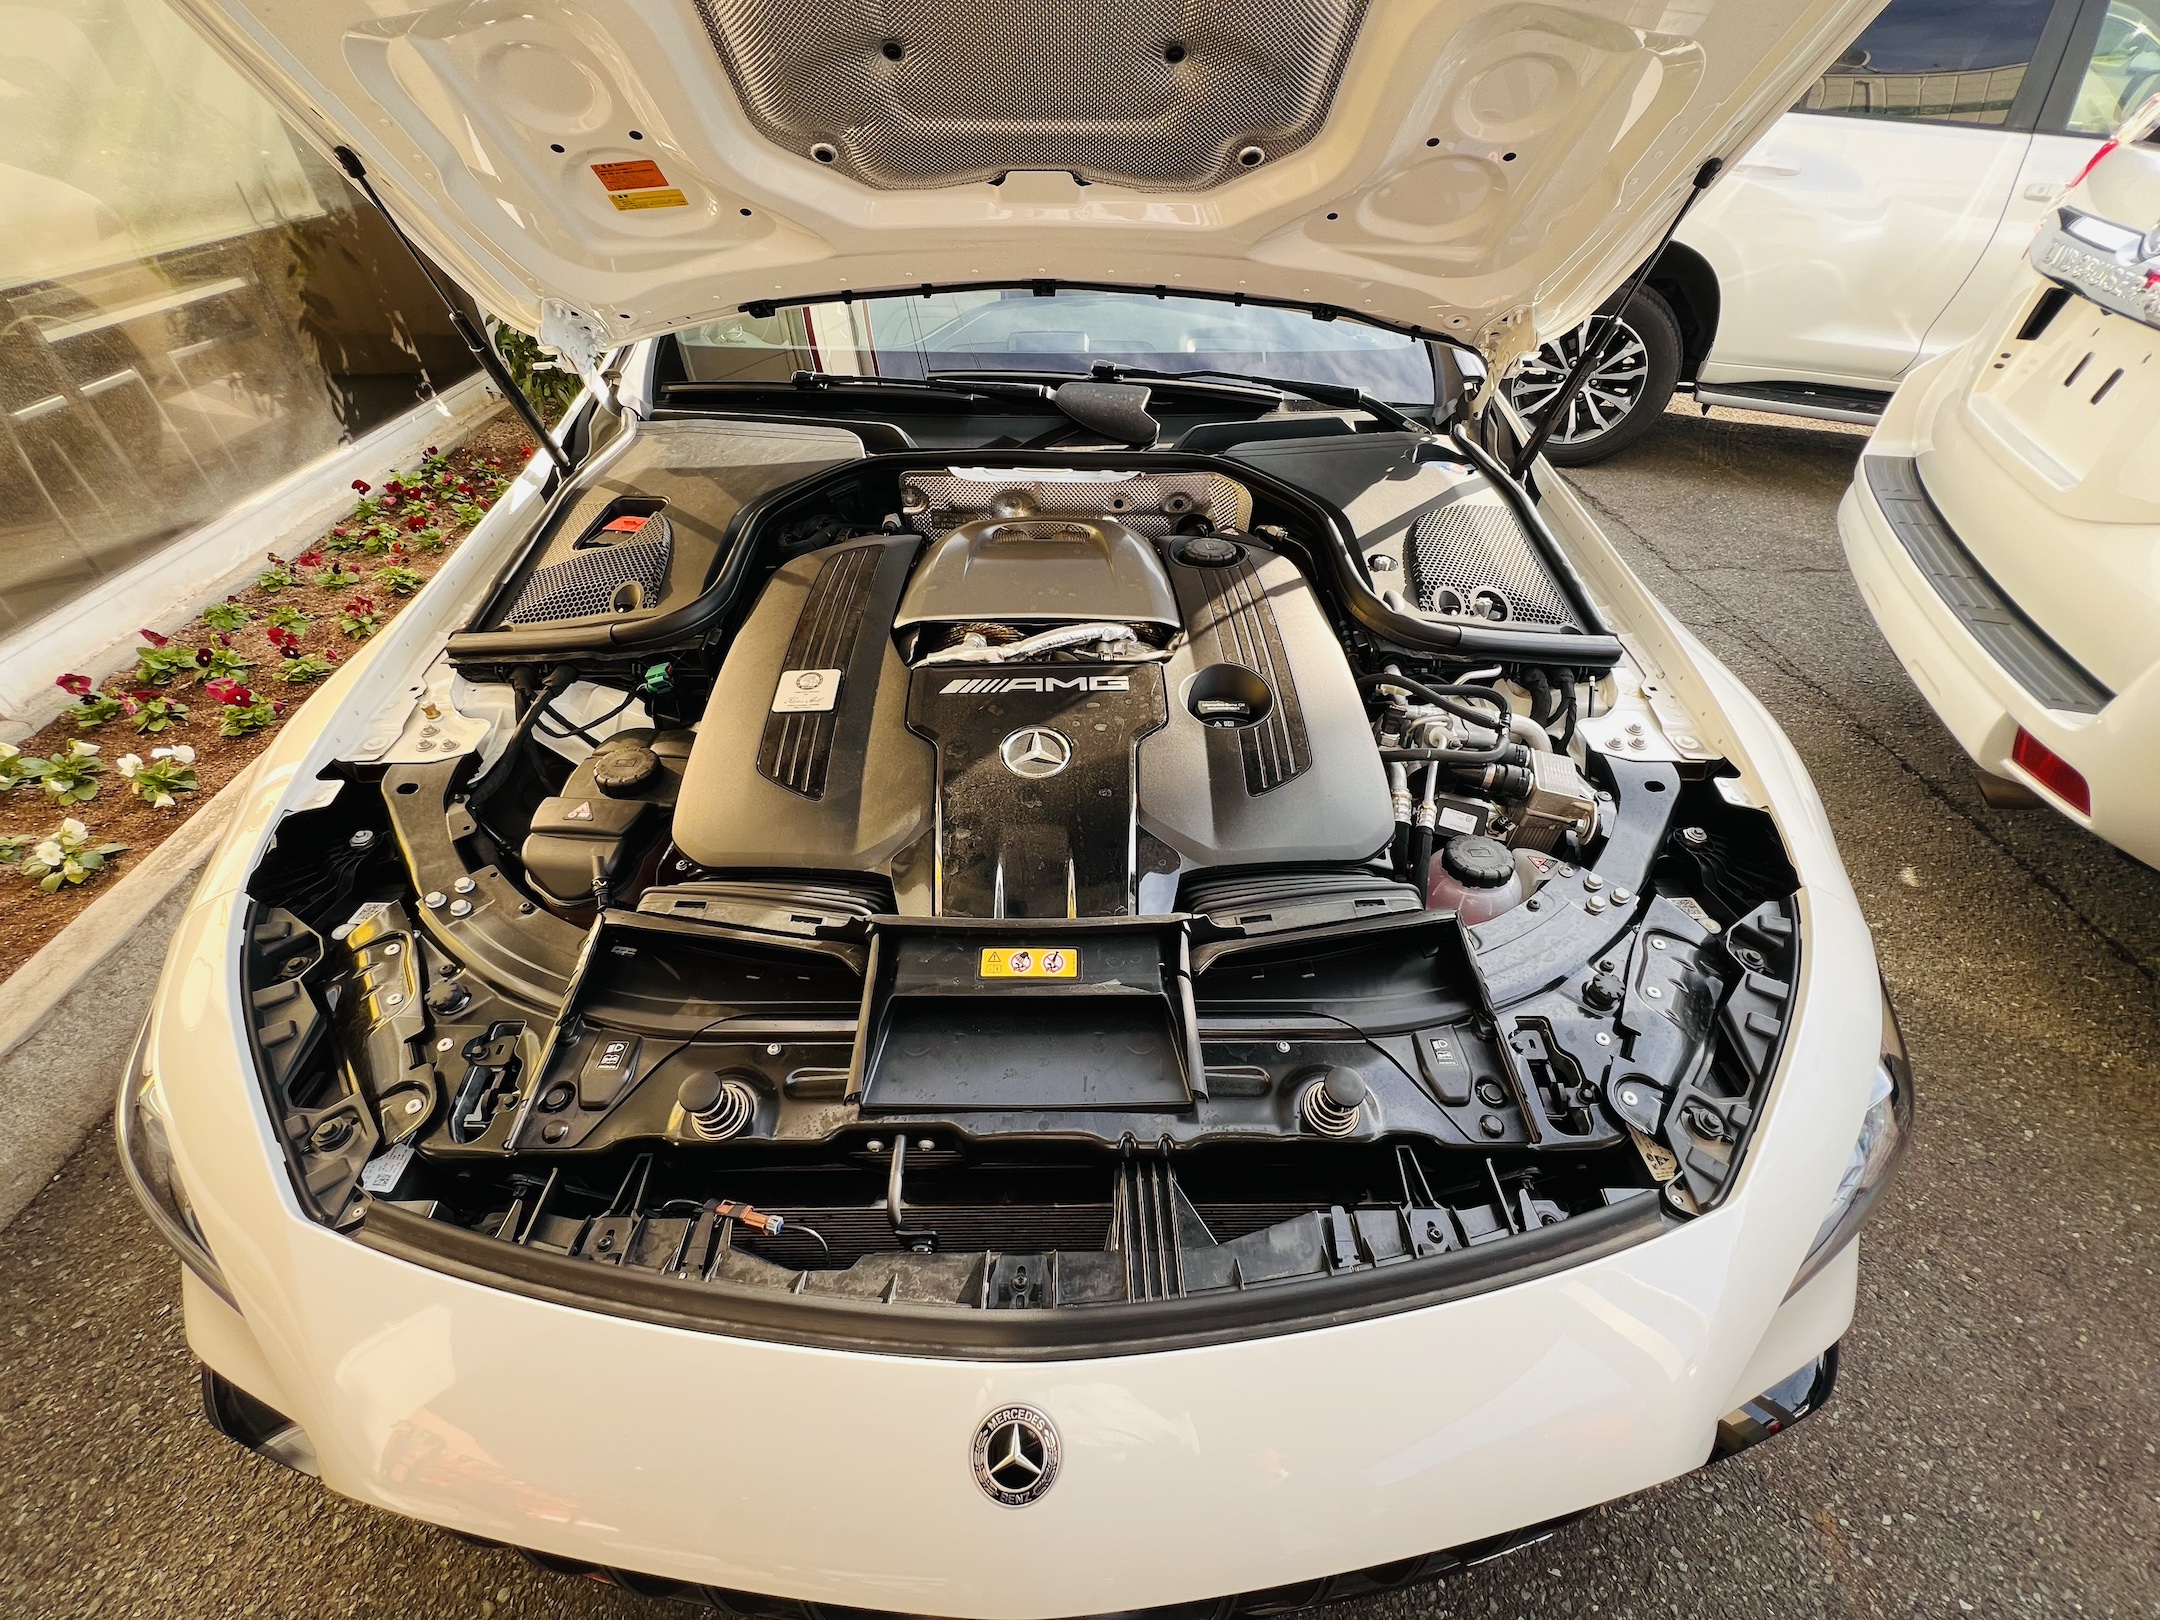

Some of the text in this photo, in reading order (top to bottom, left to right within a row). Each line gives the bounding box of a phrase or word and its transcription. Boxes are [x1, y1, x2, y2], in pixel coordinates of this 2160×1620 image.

[999, 676, 1130, 693] AMG
[987, 1408, 1046, 1431] MERCEDES
[1000, 1491, 1032, 1504] BENZ
